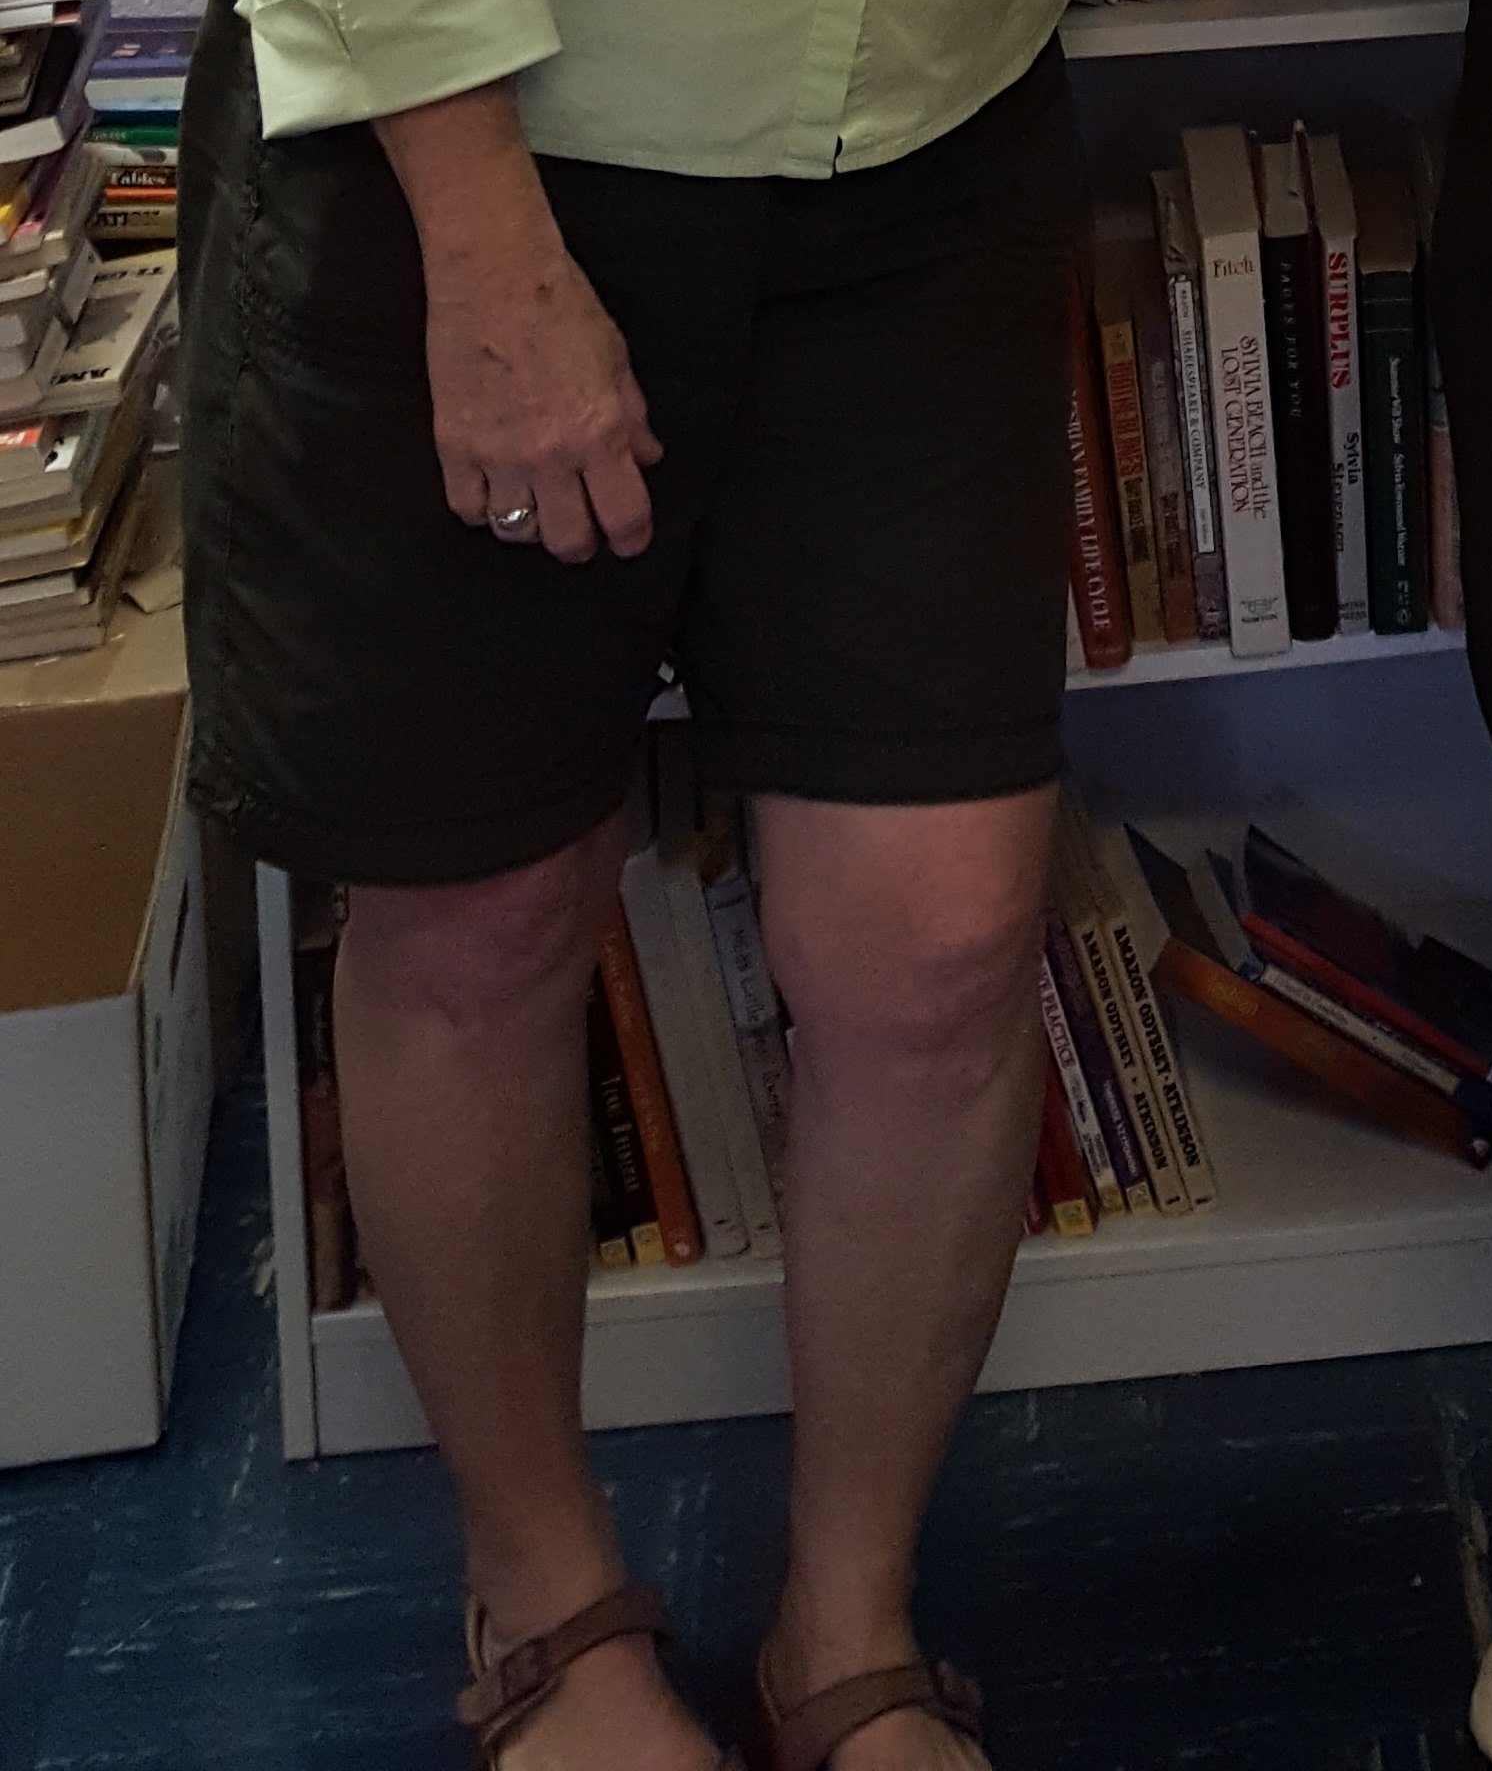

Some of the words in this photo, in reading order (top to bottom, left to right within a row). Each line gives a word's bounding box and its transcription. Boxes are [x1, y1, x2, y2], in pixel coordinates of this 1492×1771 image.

[1239, 335, 1260, 399] SYLVIA
[1329, 252, 1351, 390] SURPLUS
[1221, 347, 1238, 392] LOST
[1225, 393, 1249, 514] GENERATION
[1247, 401, 1266, 461] BEACH
[1346, 431, 1361, 484] Sylvia
[1082, 930, 1112, 999] AMAZON
[1104, 1000, 1135, 1068] ODYSSEY
[1134, 1091, 1167, 1170] ATKINSON
[1113, 926, 1148, 1002] AMAZON
[1139, 1002, 1171, 1075] ODYSSEY
[1163, 1083, 1200, 1167] ATKINSON
